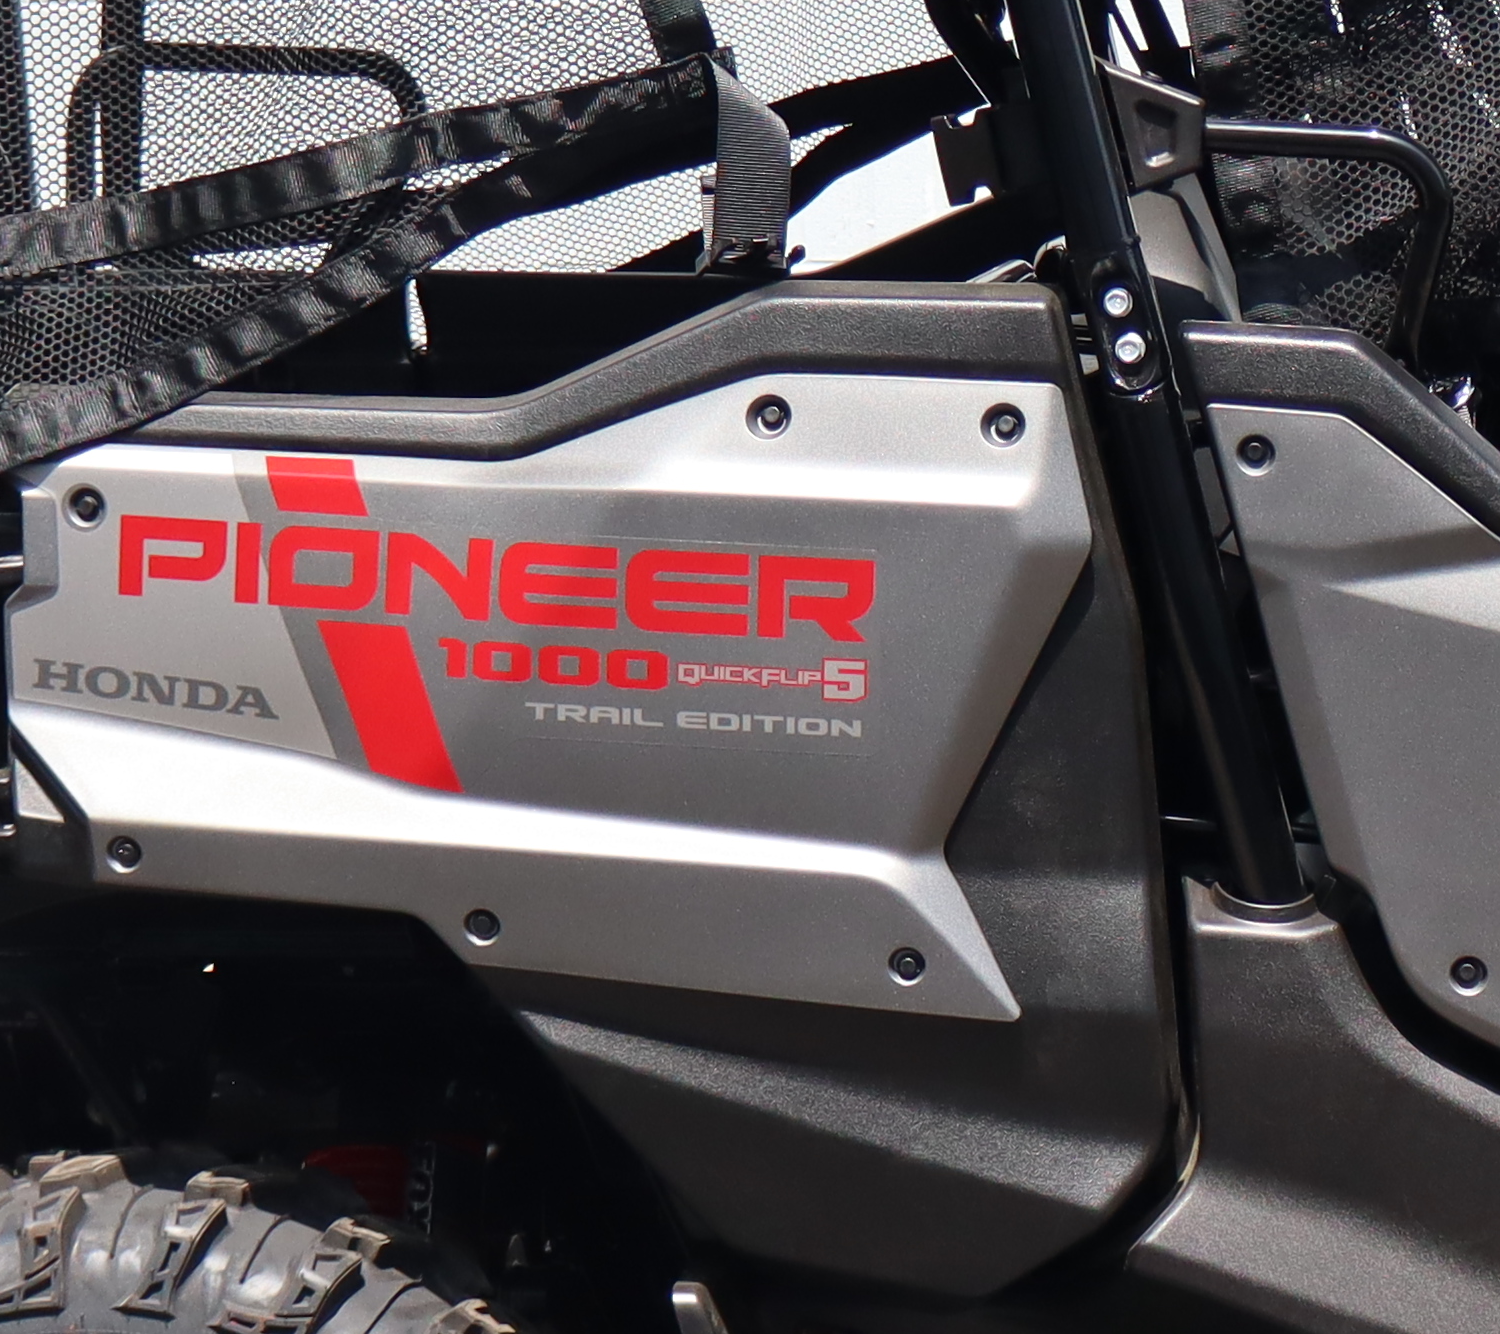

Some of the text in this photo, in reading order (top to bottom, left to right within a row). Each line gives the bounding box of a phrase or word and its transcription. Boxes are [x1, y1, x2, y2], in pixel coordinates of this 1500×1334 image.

[118, 514, 876, 642] PIONEER
[32, 657, 280, 721] HONDA
[438, 637, 670, 691] 1000
[525, 701, 863, 738] TRAIL EDITION
